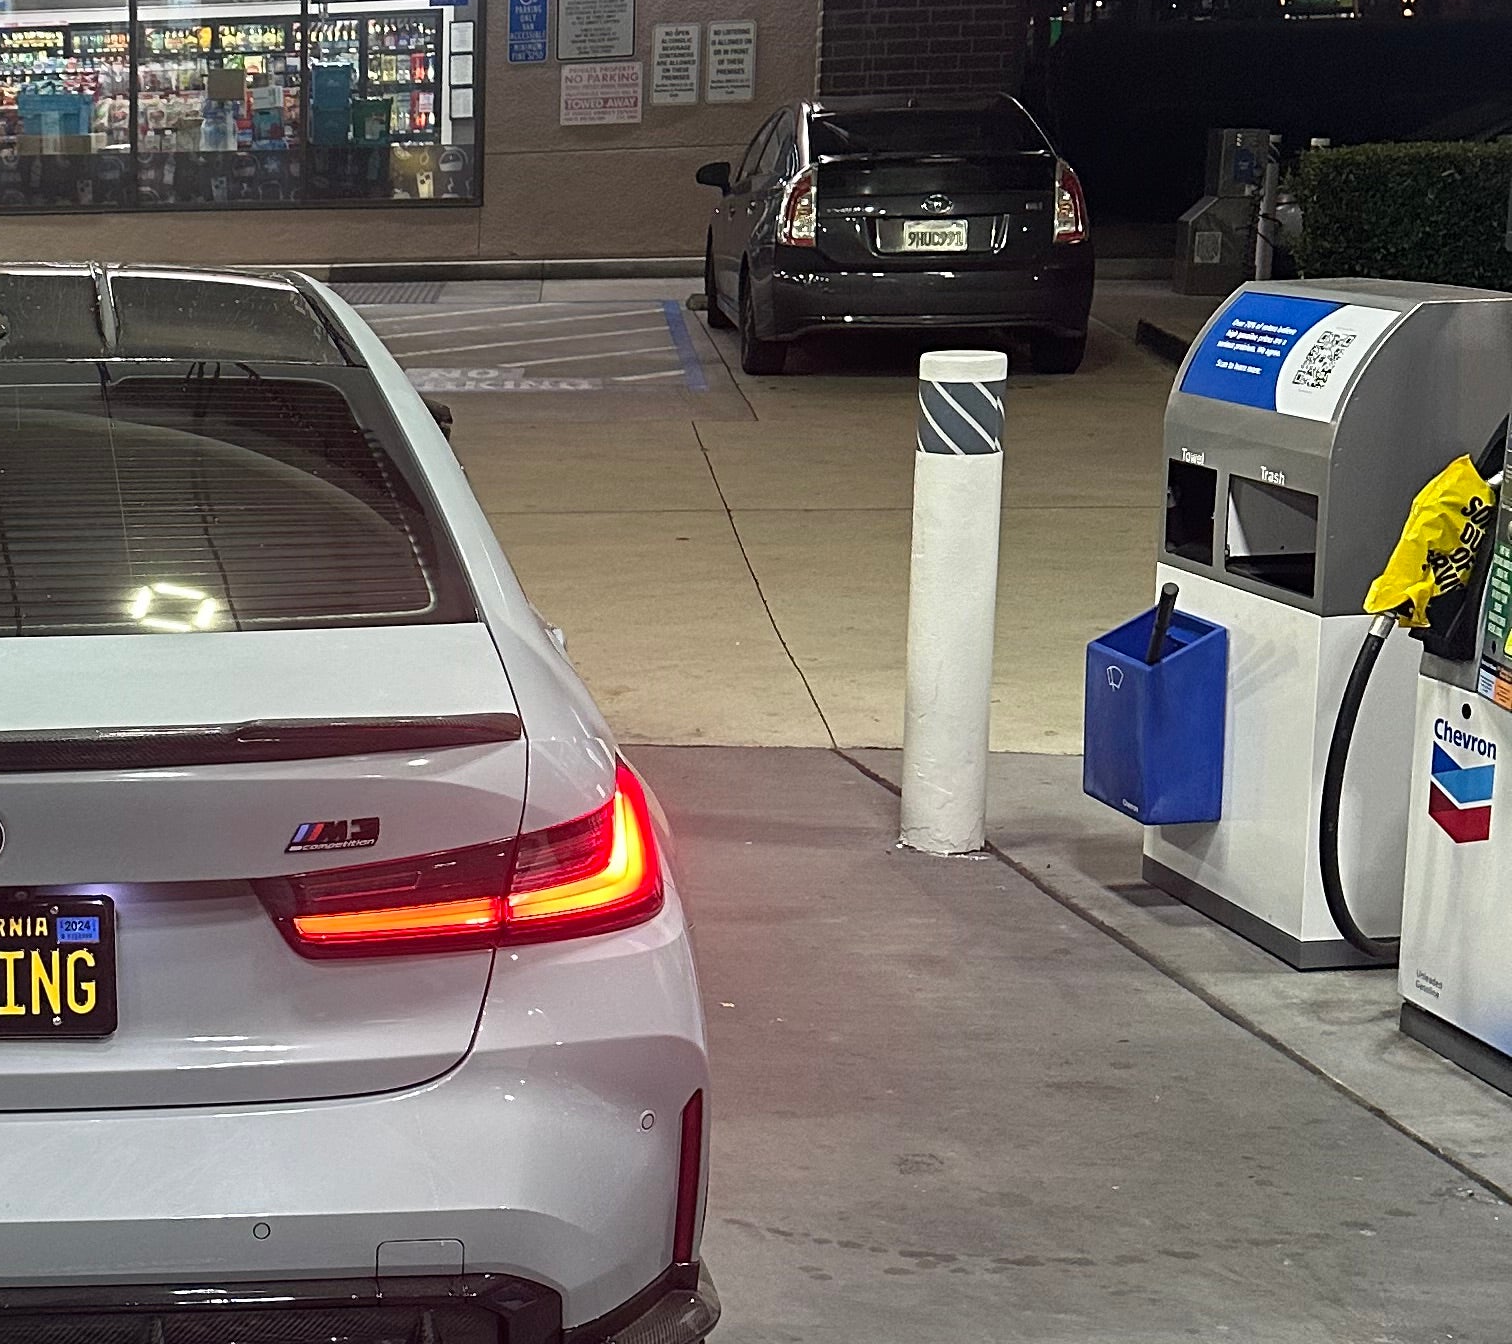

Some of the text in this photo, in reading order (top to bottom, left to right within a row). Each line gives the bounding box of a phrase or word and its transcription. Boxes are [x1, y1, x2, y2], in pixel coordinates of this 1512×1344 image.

[515, 4, 542, 14] PARKING
[520, 14, 536, 22] ONLY
[565, 72, 639, 84] NO PARKING
[566, 97, 637, 109] TOWED AWAY
[1182, 447, 1285, 485] Towel Trash
[1434, 718, 1497, 760] Chevron
[302, 839, 374, 852] competition
[64, 920, 91, 932] 2024
